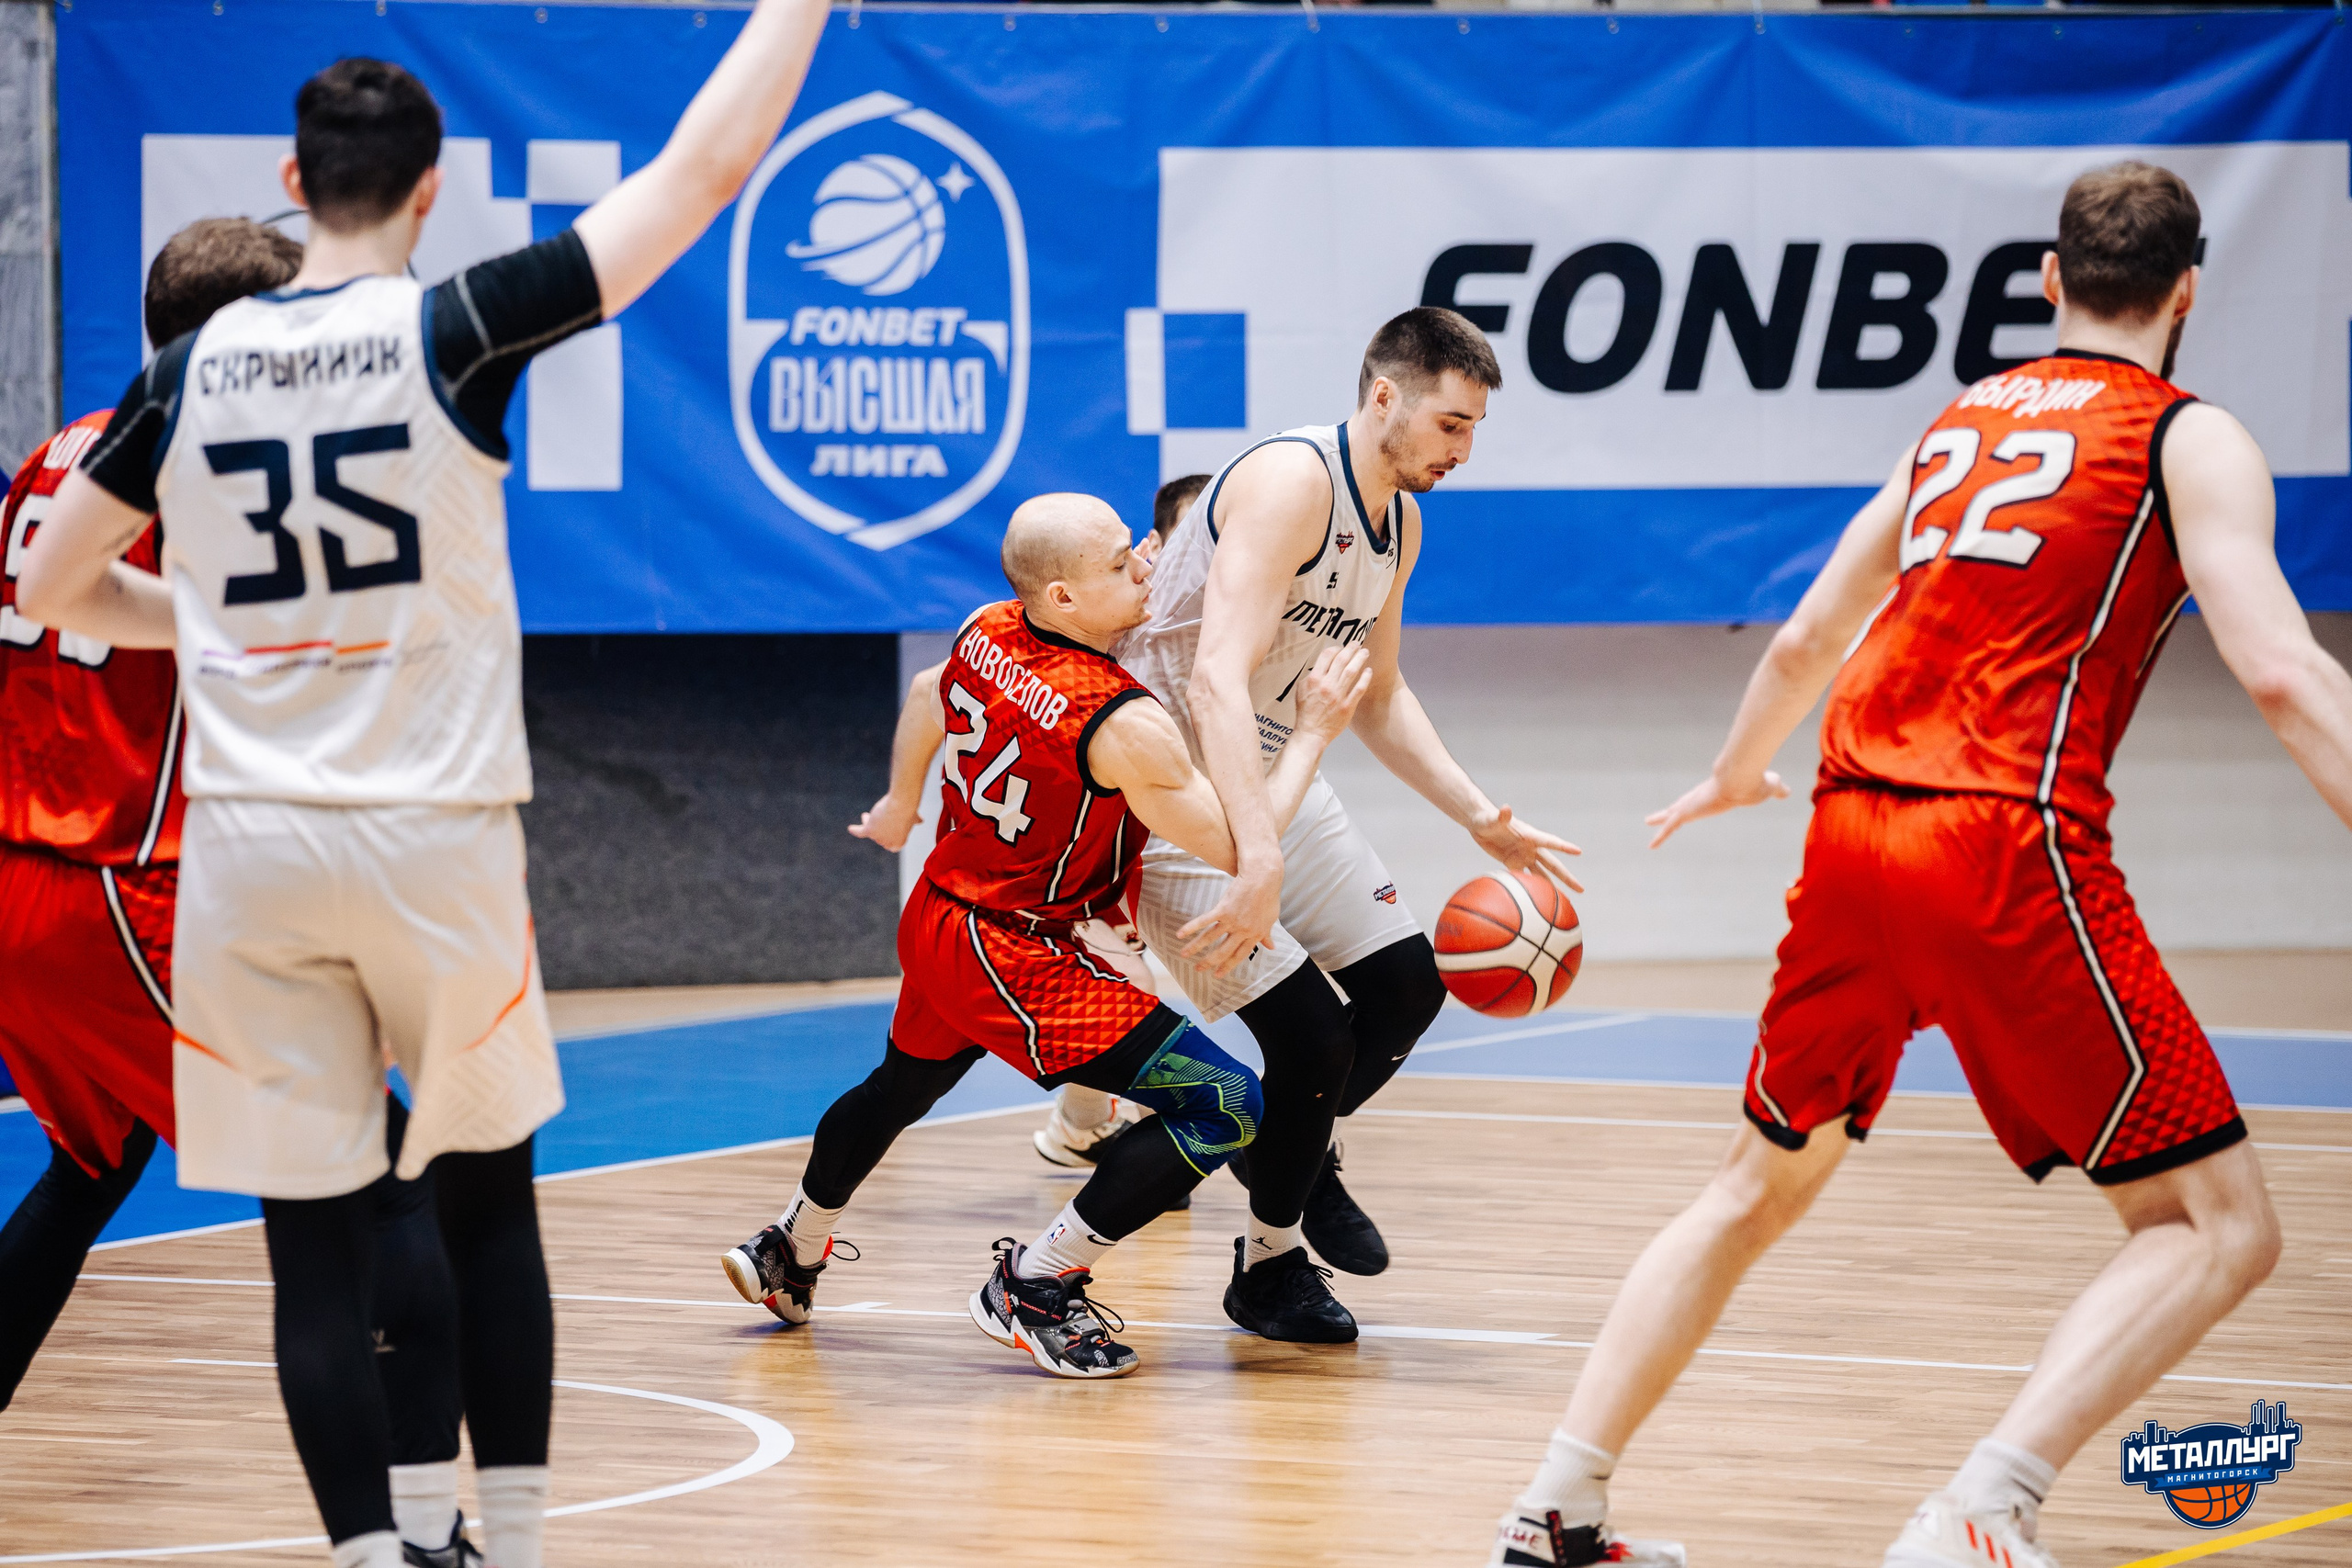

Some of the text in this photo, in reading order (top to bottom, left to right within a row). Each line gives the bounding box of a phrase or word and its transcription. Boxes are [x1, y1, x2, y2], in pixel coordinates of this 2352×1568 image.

[789, 307, 967, 346] FONBET
[1420, 238, 2207, 395] FONBE
[768, 355, 986, 434] ВЫСШАЯ
[810, 445, 949, 478] ЛИГА
[203, 423, 423, 607] 35
[1899, 426, 2076, 571] 22
[944, 678, 1035, 848] 24
